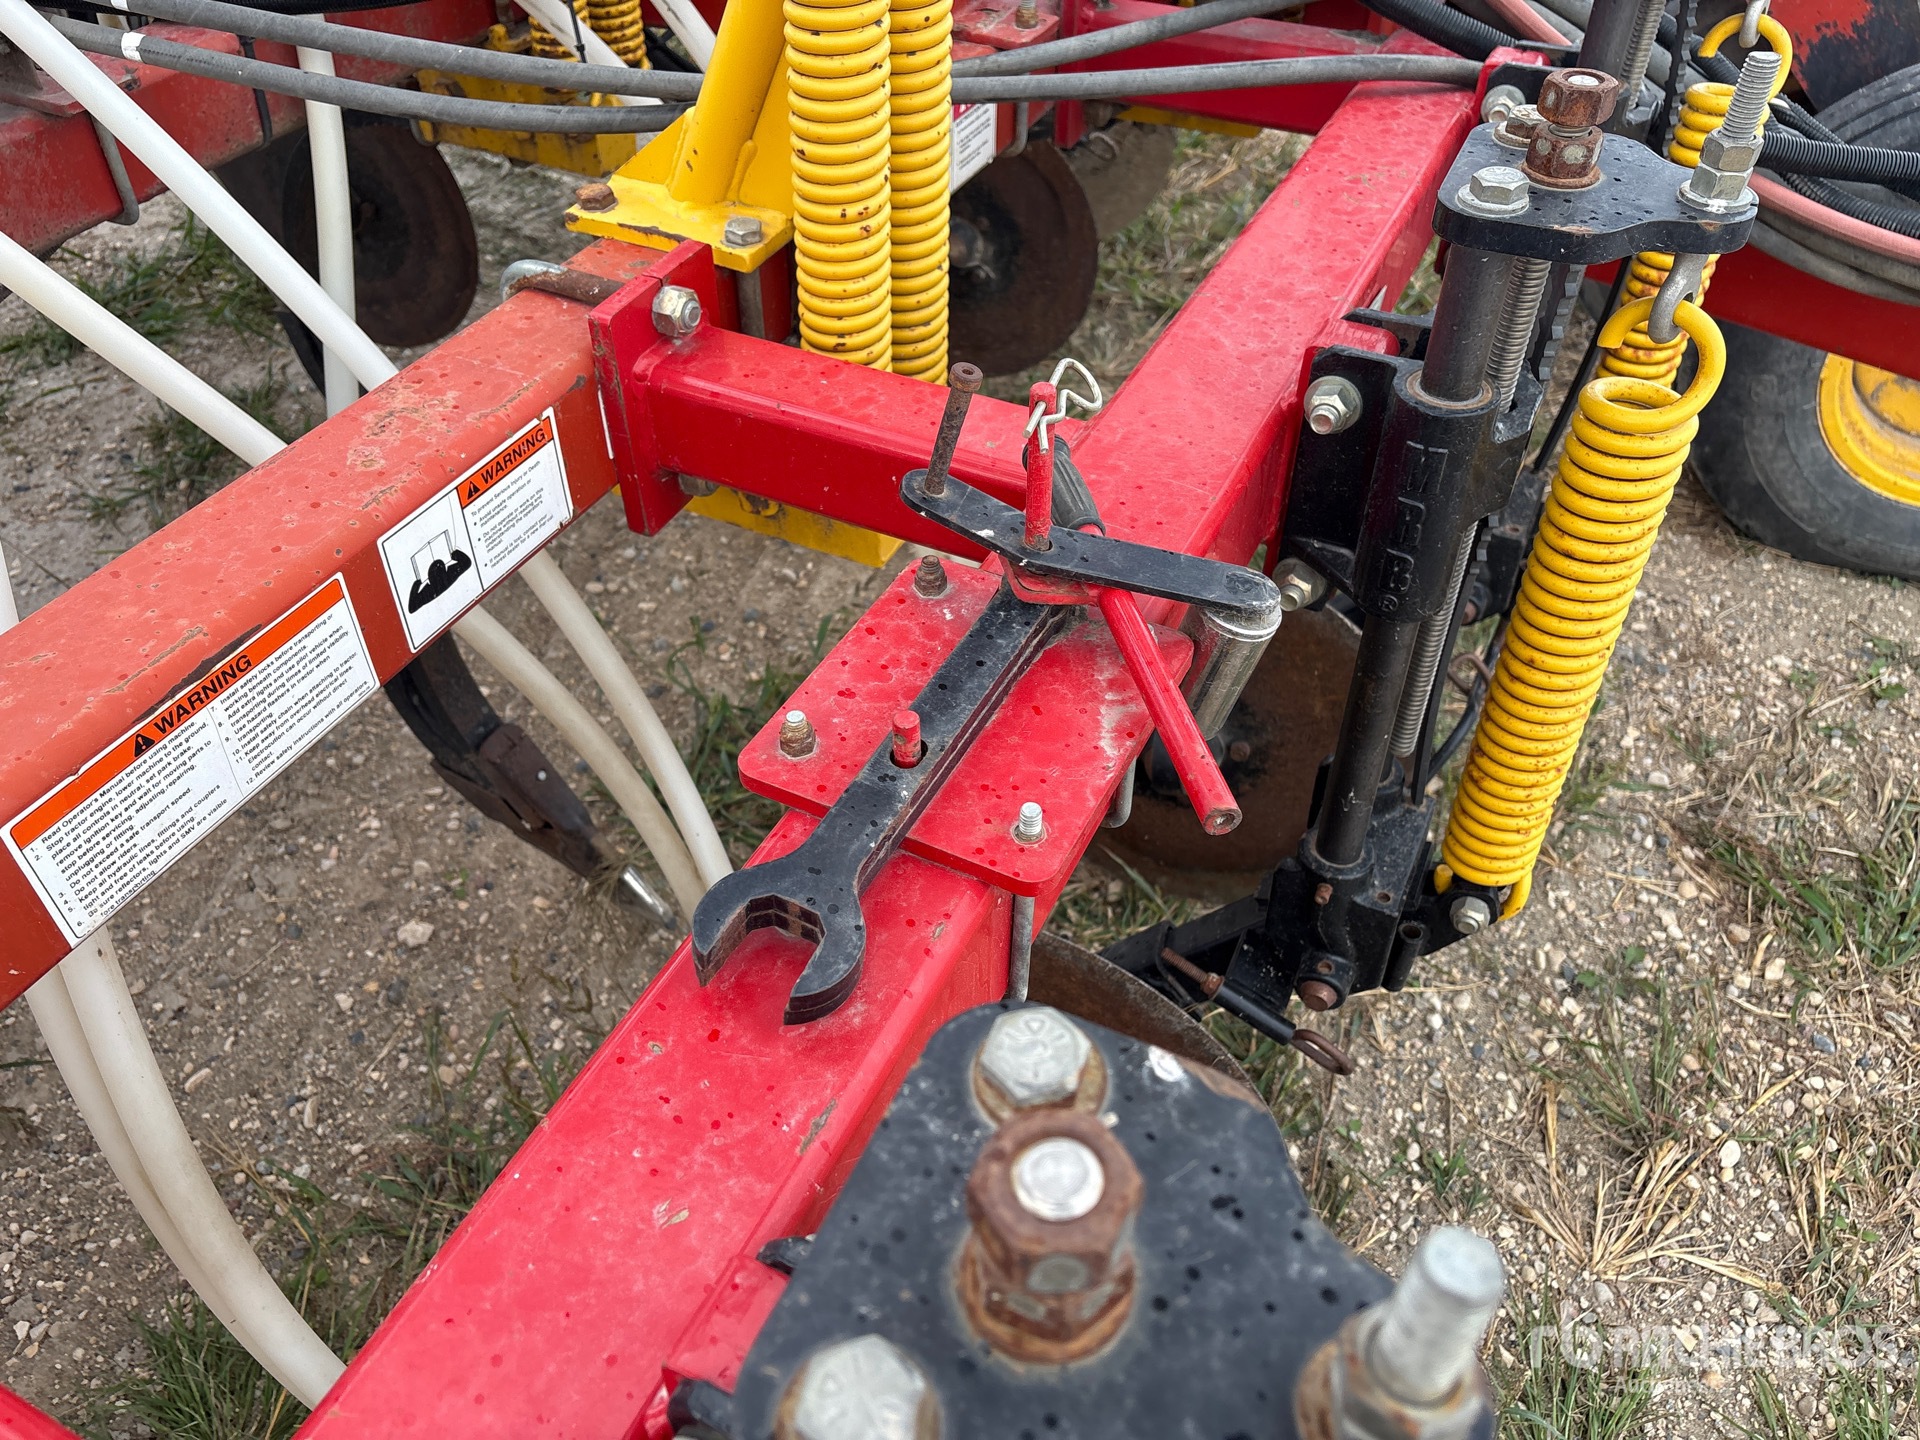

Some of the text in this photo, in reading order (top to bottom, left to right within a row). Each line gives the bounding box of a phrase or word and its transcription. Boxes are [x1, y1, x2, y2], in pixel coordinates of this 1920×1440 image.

[480, 427, 546, 485] WARNING
[152, 654, 252, 734] WARNING
[219, 686, 240, 705] Install
[239, 672, 258, 690] safety
[257, 660, 275, 675] locks
[273, 645, 294, 662] before
[292, 618, 327, 647] transporting
[326, 613, 333, 621] or
[223, 691, 249, 713] working
[247, 672, 273, 694] beneath
[227, 706, 241, 721] Add
[240, 695, 256, 710] extra
[255, 681, 273, 697] lights
[272, 671, 285, 684] and
[284, 663, 296, 674] use
[295, 652, 309, 667] pilot
[308, 636, 328, 655] vehicle
[328, 624, 344, 639] when
[230, 696, 267, 728] transporting
[266, 681, 286, 699] during
[285, 668, 302, 683] times
[301, 661, 308, 671] of
[307, 646, 327, 665] limited
[233, 722, 247, 735] Use
[246, 705, 268, 725] hazard
[266, 687, 291, 709] flashers
[289, 682, 297, 690] in
[296, 666, 315, 684] tractor
[314, 654, 331, 669] when
[240, 731, 260, 750] Install
[259, 717, 277, 735] safety
[277, 704, 294, 720] chain
[292, 692, 309, 706] when
[308, 671, 334, 694] attaching
[332, 666, 340, 674] to
[243, 742, 260, 757] Keep
[260, 729, 276, 744] away
[274, 717, 290, 731] from
[289, 695, 315, 720] overhead
[314, 674, 340, 698] electrical
[247, 731, 286, 764] Electrocution
[285, 721, 297, 733] can
[296, 708, 312, 724] occur
[311, 690, 332, 710] without
[331, 677, 348, 694] direct
[253, 758, 276, 779] Review
[275, 743, 293, 761] safety
[292, 717, 325, 746] instructions
[323, 707, 336, 719] with
[335, 700, 343, 710] all
[40, 825, 62, 844] Read
[61, 796, 99, 828] Operator's
[98, 775, 125, 799] Manual
[124, 758, 148, 778] before
[147, 742, 168, 760] using
[45, 835, 64, 852] Stop
[63, 815, 88, 837] tractor
[114, 779, 134, 797] lower
[134, 756, 164, 781] machine
[163, 750, 172, 758] to
[171, 741, 184, 752] the
[50, 841, 72, 861] place
[71, 832, 82, 843] all
[81, 809, 111, 835] controls
[110, 803, 119, 812] in
[144, 772, 157, 784] set
[156, 760, 173, 776] park
[55, 739, 212, 867] remove ignition key and wait for moving parts to
[60, 859, 77, 875] stop
[76, 840, 101, 861] before
[64, 847, 106, 882] unplugging
[105, 840, 113, 849] or
[68, 878, 81, 889] Do
[80, 867, 94, 880] not
[93, 845, 119, 869] exceed
[124, 829, 140, 844] safe
[139, 804, 171, 831] transport
[73, 885, 86, 899] Do
[85, 874, 99, 887] not
[98, 859, 117, 877] allow
[77, 886, 98, 904] Keep
[97, 877, 108, 888] all
[106, 852, 139, 880] hydraulic
[156, 817, 180, 838] fittings
[180, 805, 194, 819] and
[193, 784, 221, 808] couplers
[82, 894, 100, 911] tight
[99, 882, 114, 897] and
[113, 871, 128, 885] free
[128, 863, 137, 873] of
[135, 849, 155, 866] leaks
[153, 831, 176, 851] before
[98, 893, 115, 909] sure
[147, 849, 168, 866] lights
[167, 836, 181, 851] and
[179, 823, 195, 840] SMV
[195, 815, 207, 827] are
[206, 798, 228, 817] visible
